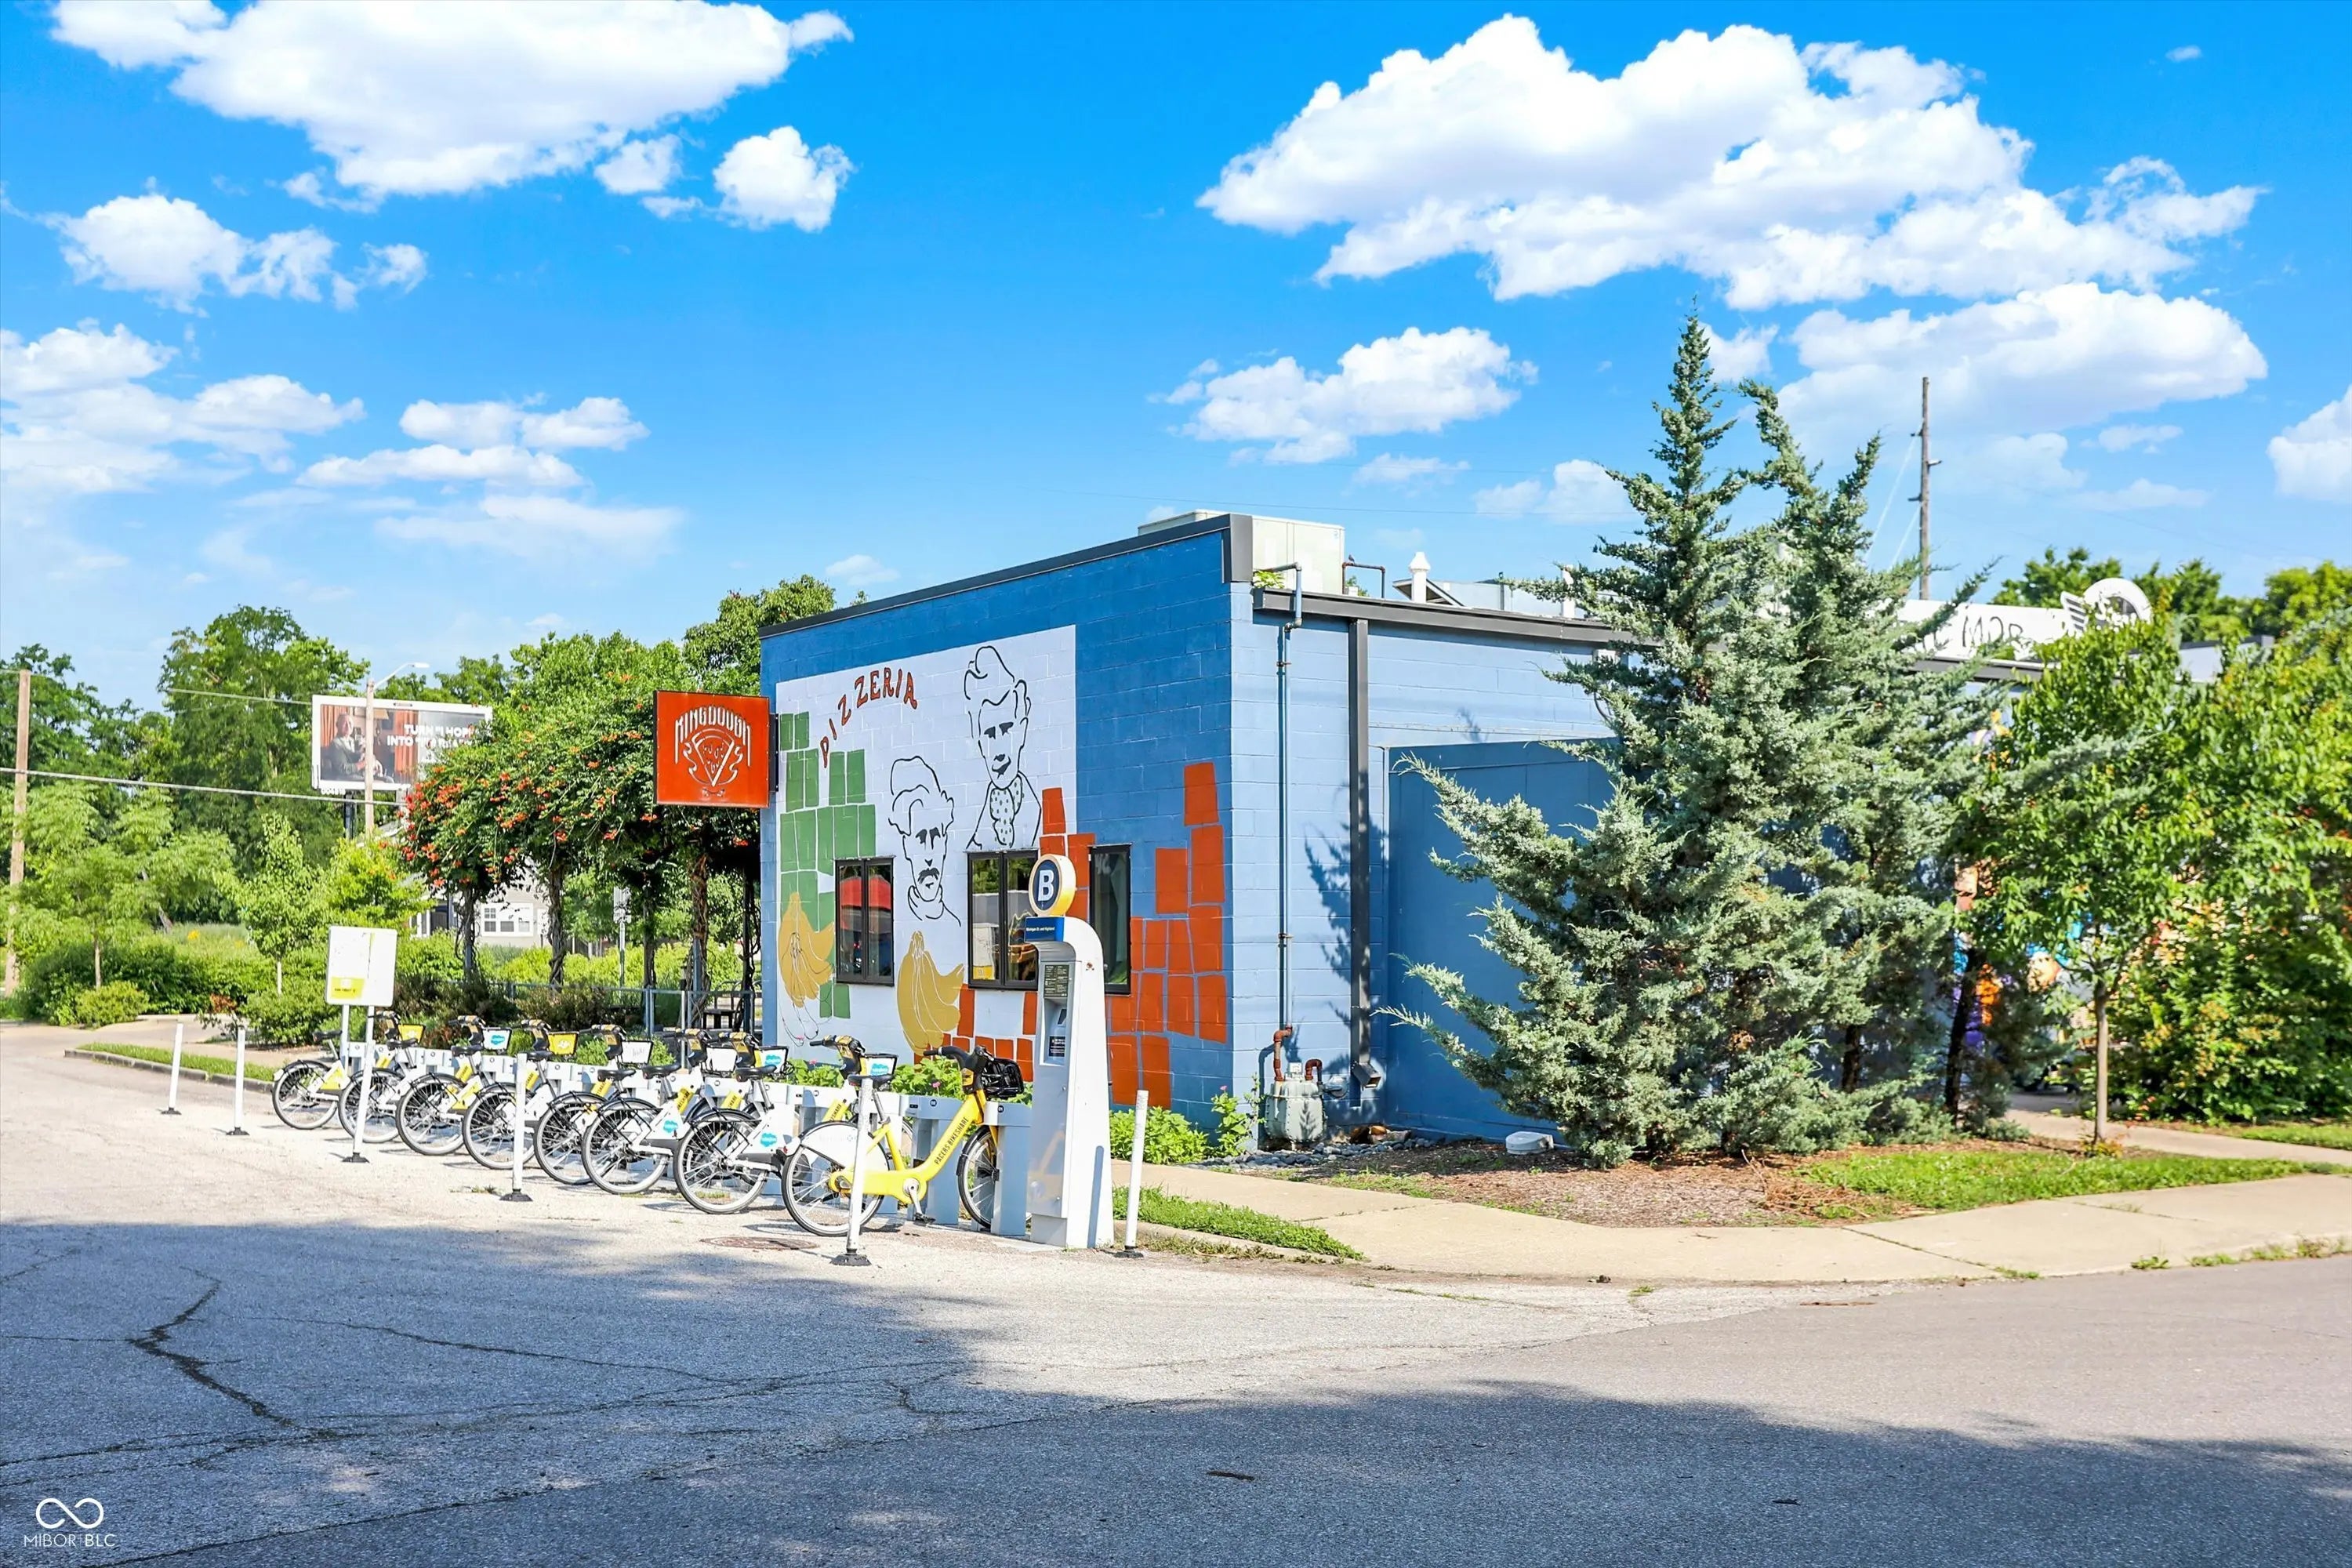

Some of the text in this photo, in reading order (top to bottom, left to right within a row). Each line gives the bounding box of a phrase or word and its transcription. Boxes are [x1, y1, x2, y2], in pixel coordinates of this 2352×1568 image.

[404, 724, 434, 735] TURN
[445, 726, 474, 739] HOP
[674, 706, 752, 767] KINGDOUGH
[820, 667, 917, 768] PIZZERIA
[387, 735, 414, 746] INTO
[1037, 869, 1054, 902] B
[934, 1116, 969, 1165] PACERS BIKESHARE
